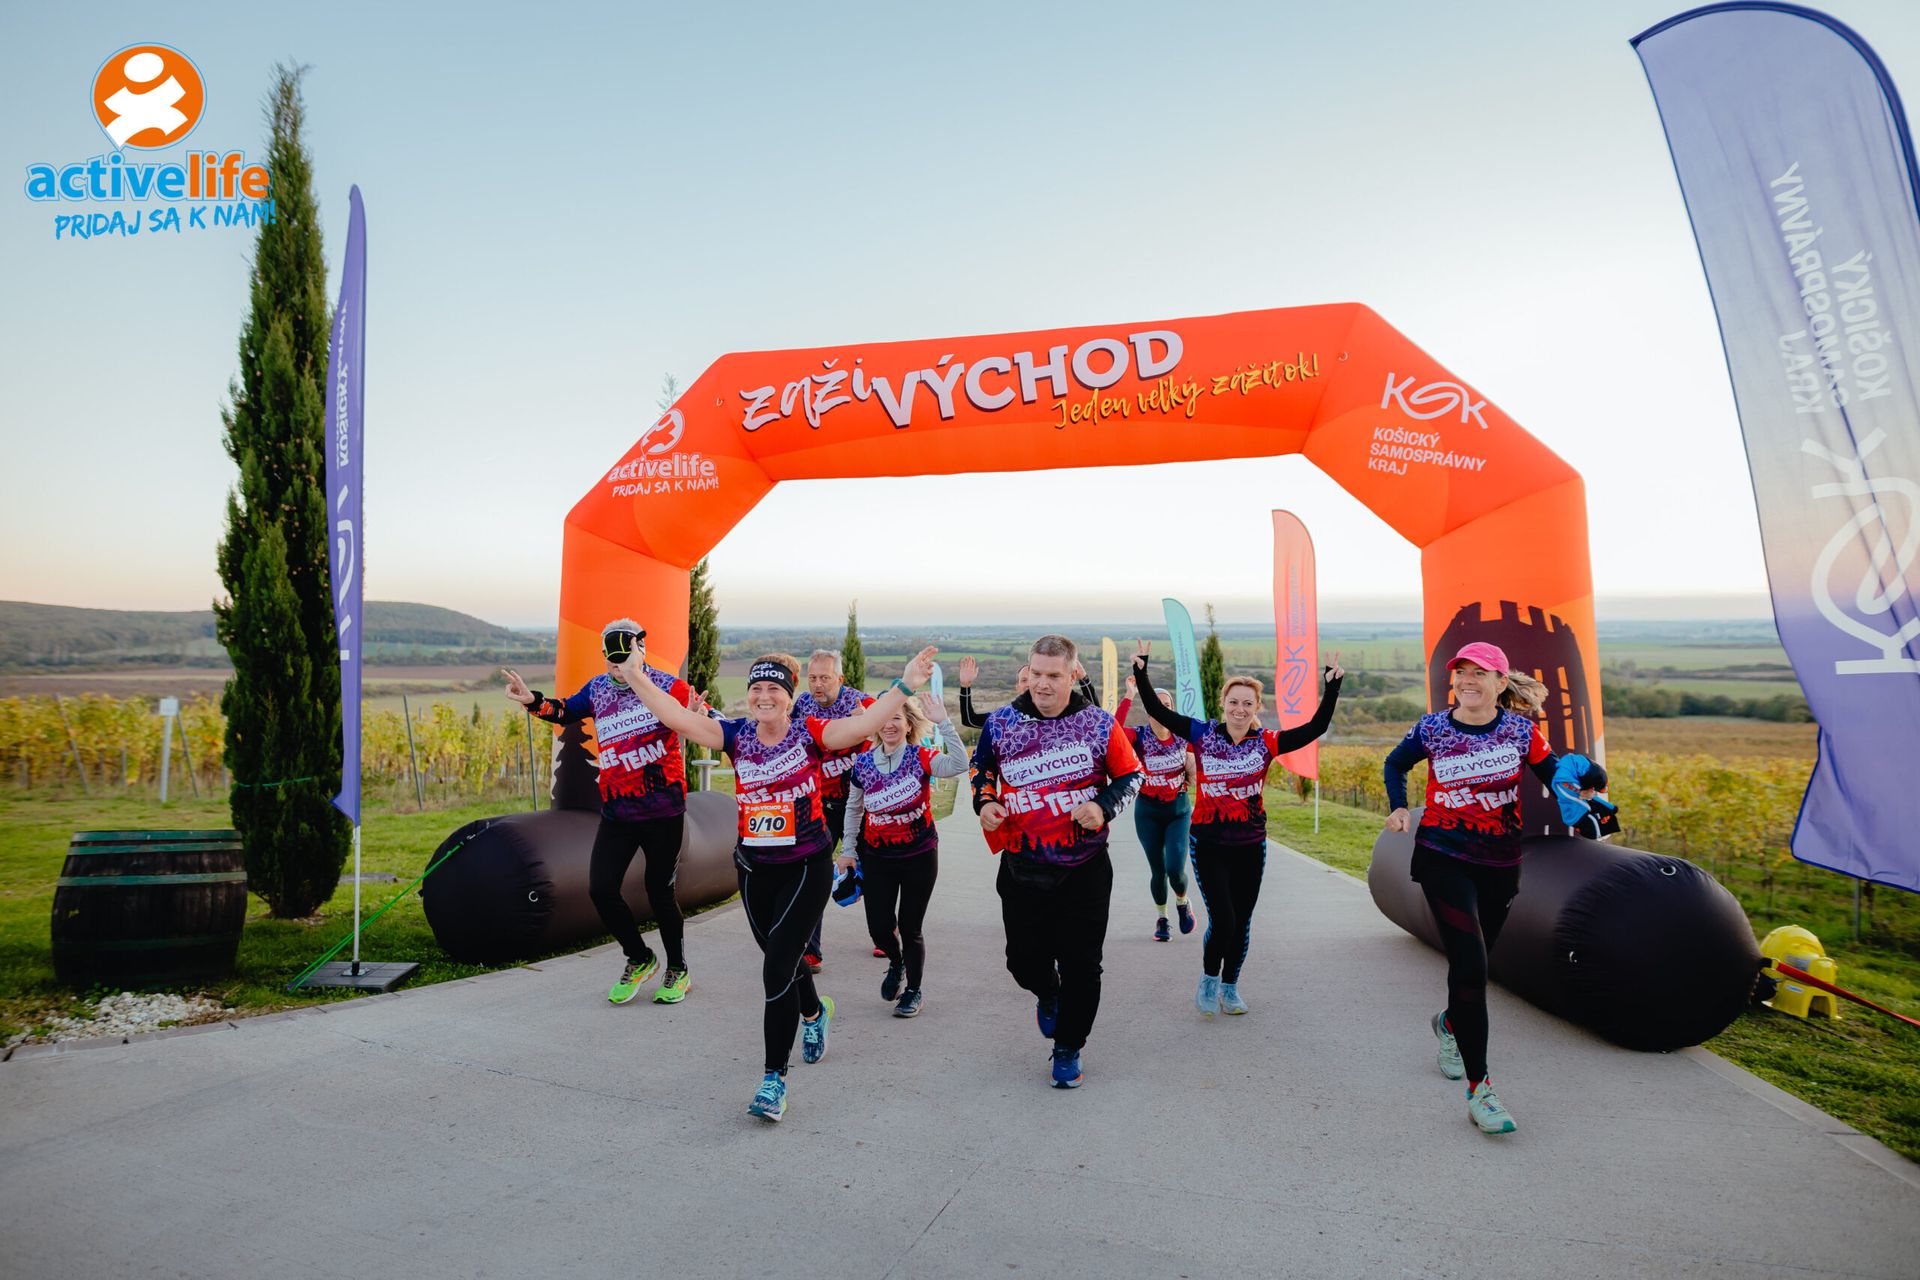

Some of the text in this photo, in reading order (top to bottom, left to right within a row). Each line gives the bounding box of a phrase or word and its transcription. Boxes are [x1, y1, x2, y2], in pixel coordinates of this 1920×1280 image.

[873, 330, 1185, 429] VÝCHOD
[1051, 388, 1131, 429] Jeden
[1210, 352, 1319, 395] zážitok!
[1373, 426, 1440, 448] KOŠICKÝ
[607, 453, 716, 483] activelife
[1368, 458, 1408, 475] KRAJ
[1370, 443, 1486, 472] SAMOSPRÁVNY
[612, 482, 651, 498] PRIDAJ
[655, 481, 670, 494] SA
[674, 480, 684, 492] K
[599, 739, 668, 772] EE TEAM
[1035, 753, 1088, 773] VÝCHOD
[1467, 753, 1517, 771] VÝCHOD
[773, 776, 816, 802] TEAM
[1434, 786, 1477, 809] FREE
[749, 816, 786, 833] 9/10
